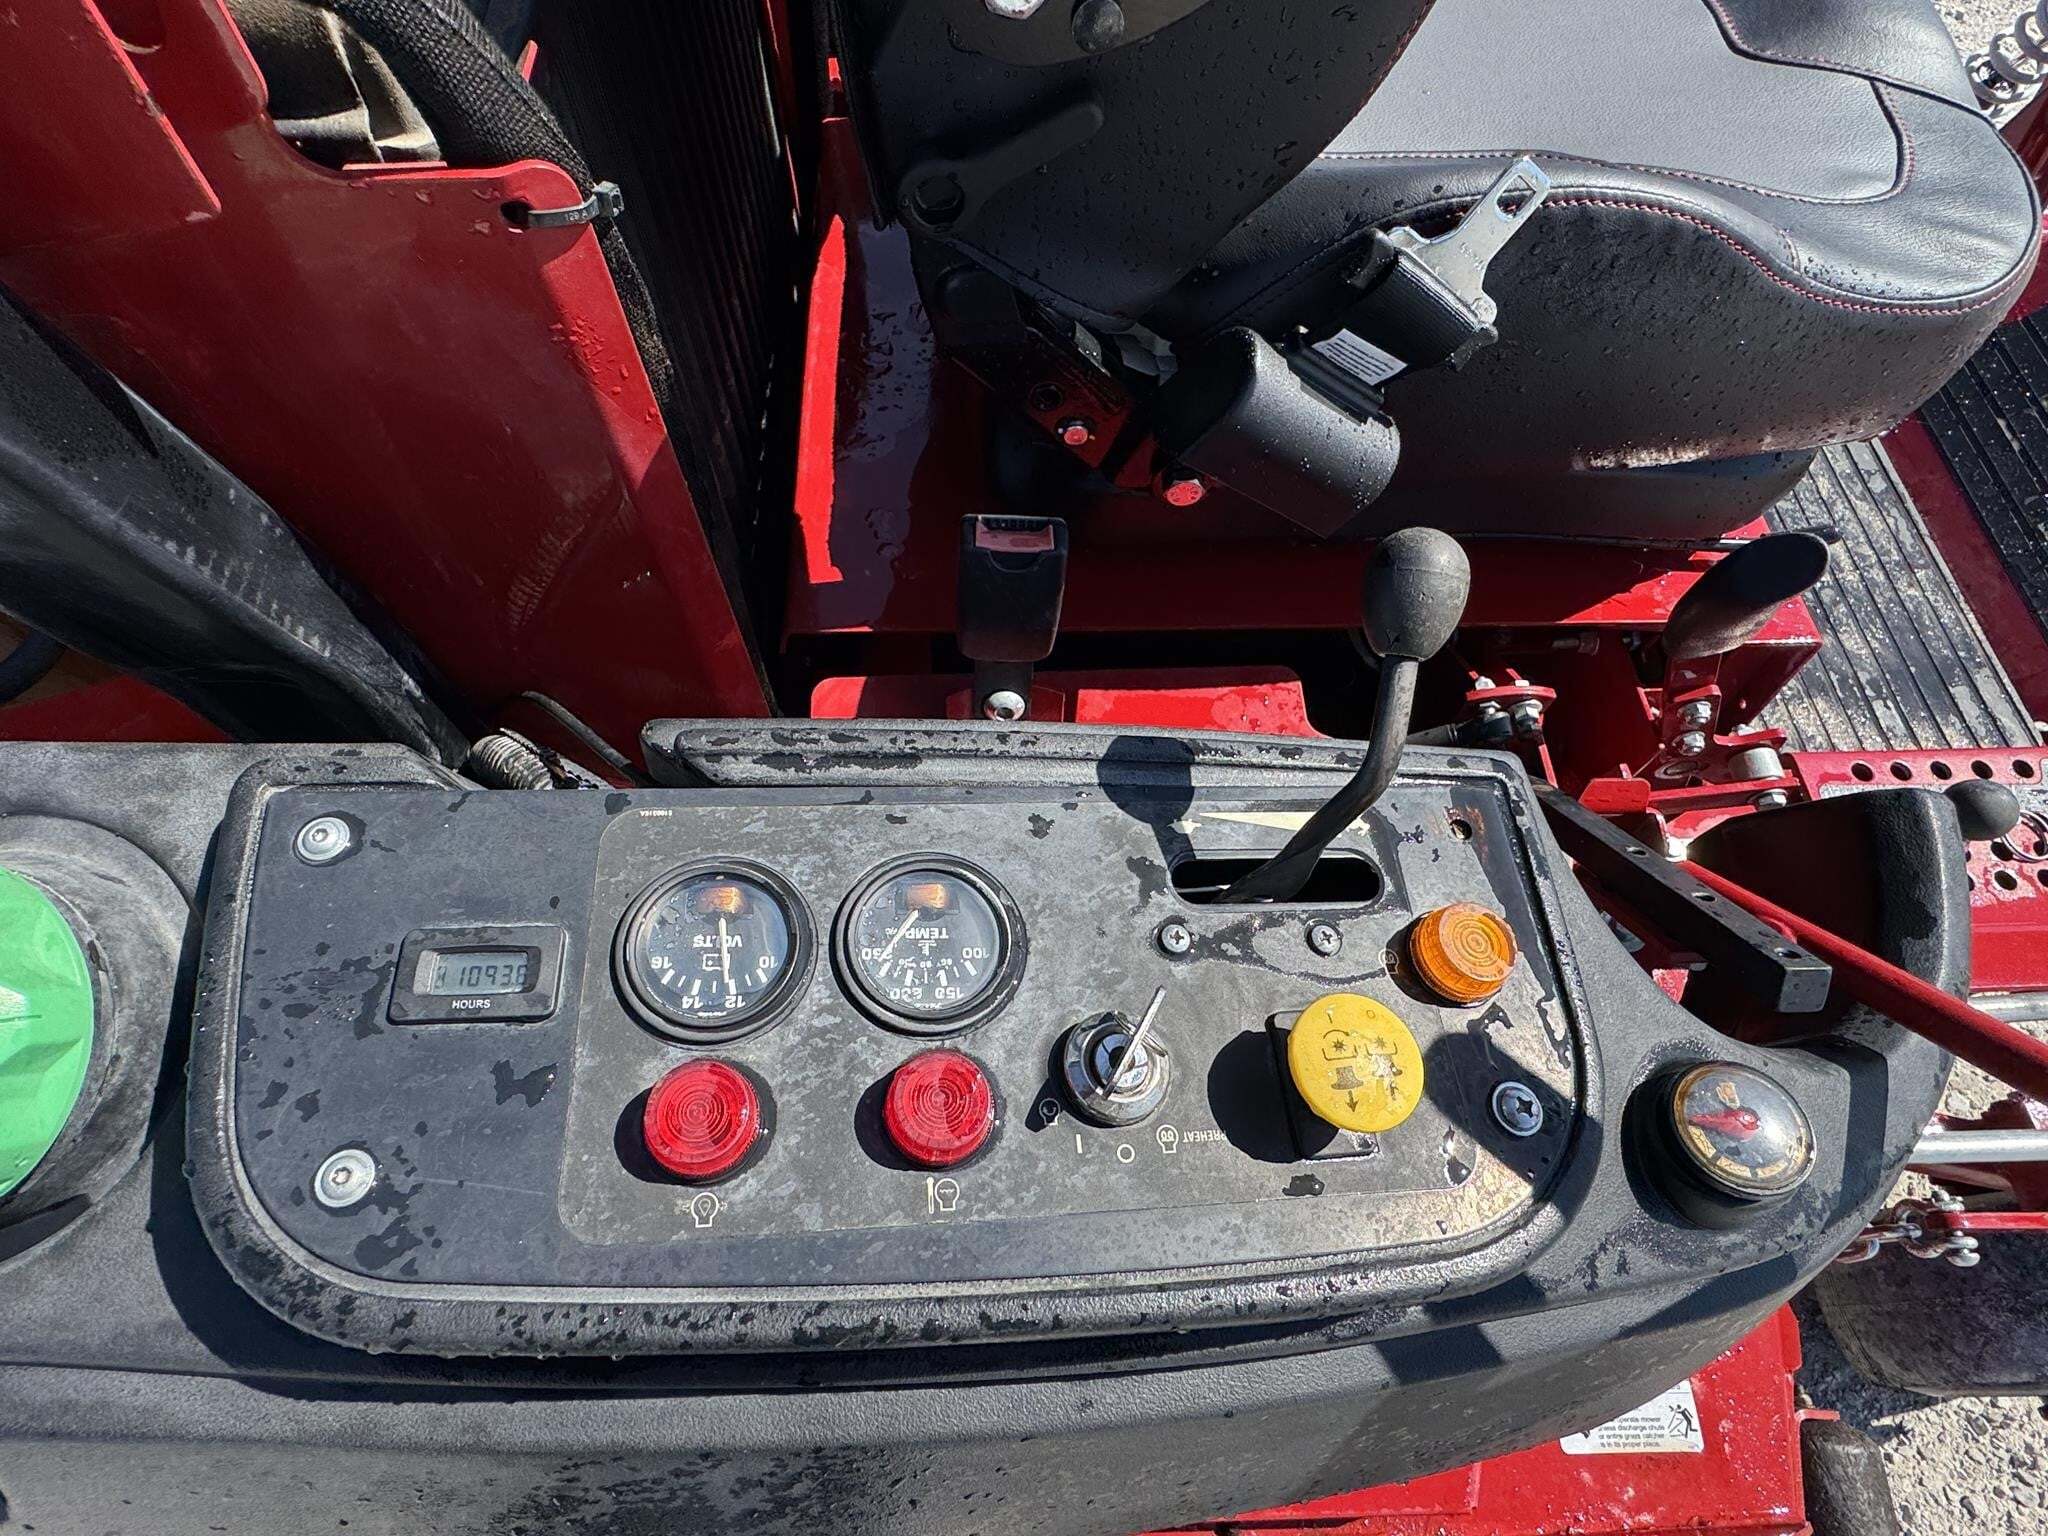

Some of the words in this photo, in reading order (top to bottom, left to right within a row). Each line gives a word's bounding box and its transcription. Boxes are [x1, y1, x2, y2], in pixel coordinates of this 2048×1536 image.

[904, 927, 949, 939] TEMP
[962, 947, 989, 959] 100
[651, 956, 672, 969] 16
[759, 955, 777, 968] 10
[934, 987, 964, 999] 150
[451, 999, 491, 1009] HOURS
[681, 995, 704, 1009] 14
[725, 995, 746, 1008] 12
[1182, 1129, 1227, 1143] PREHEAT
